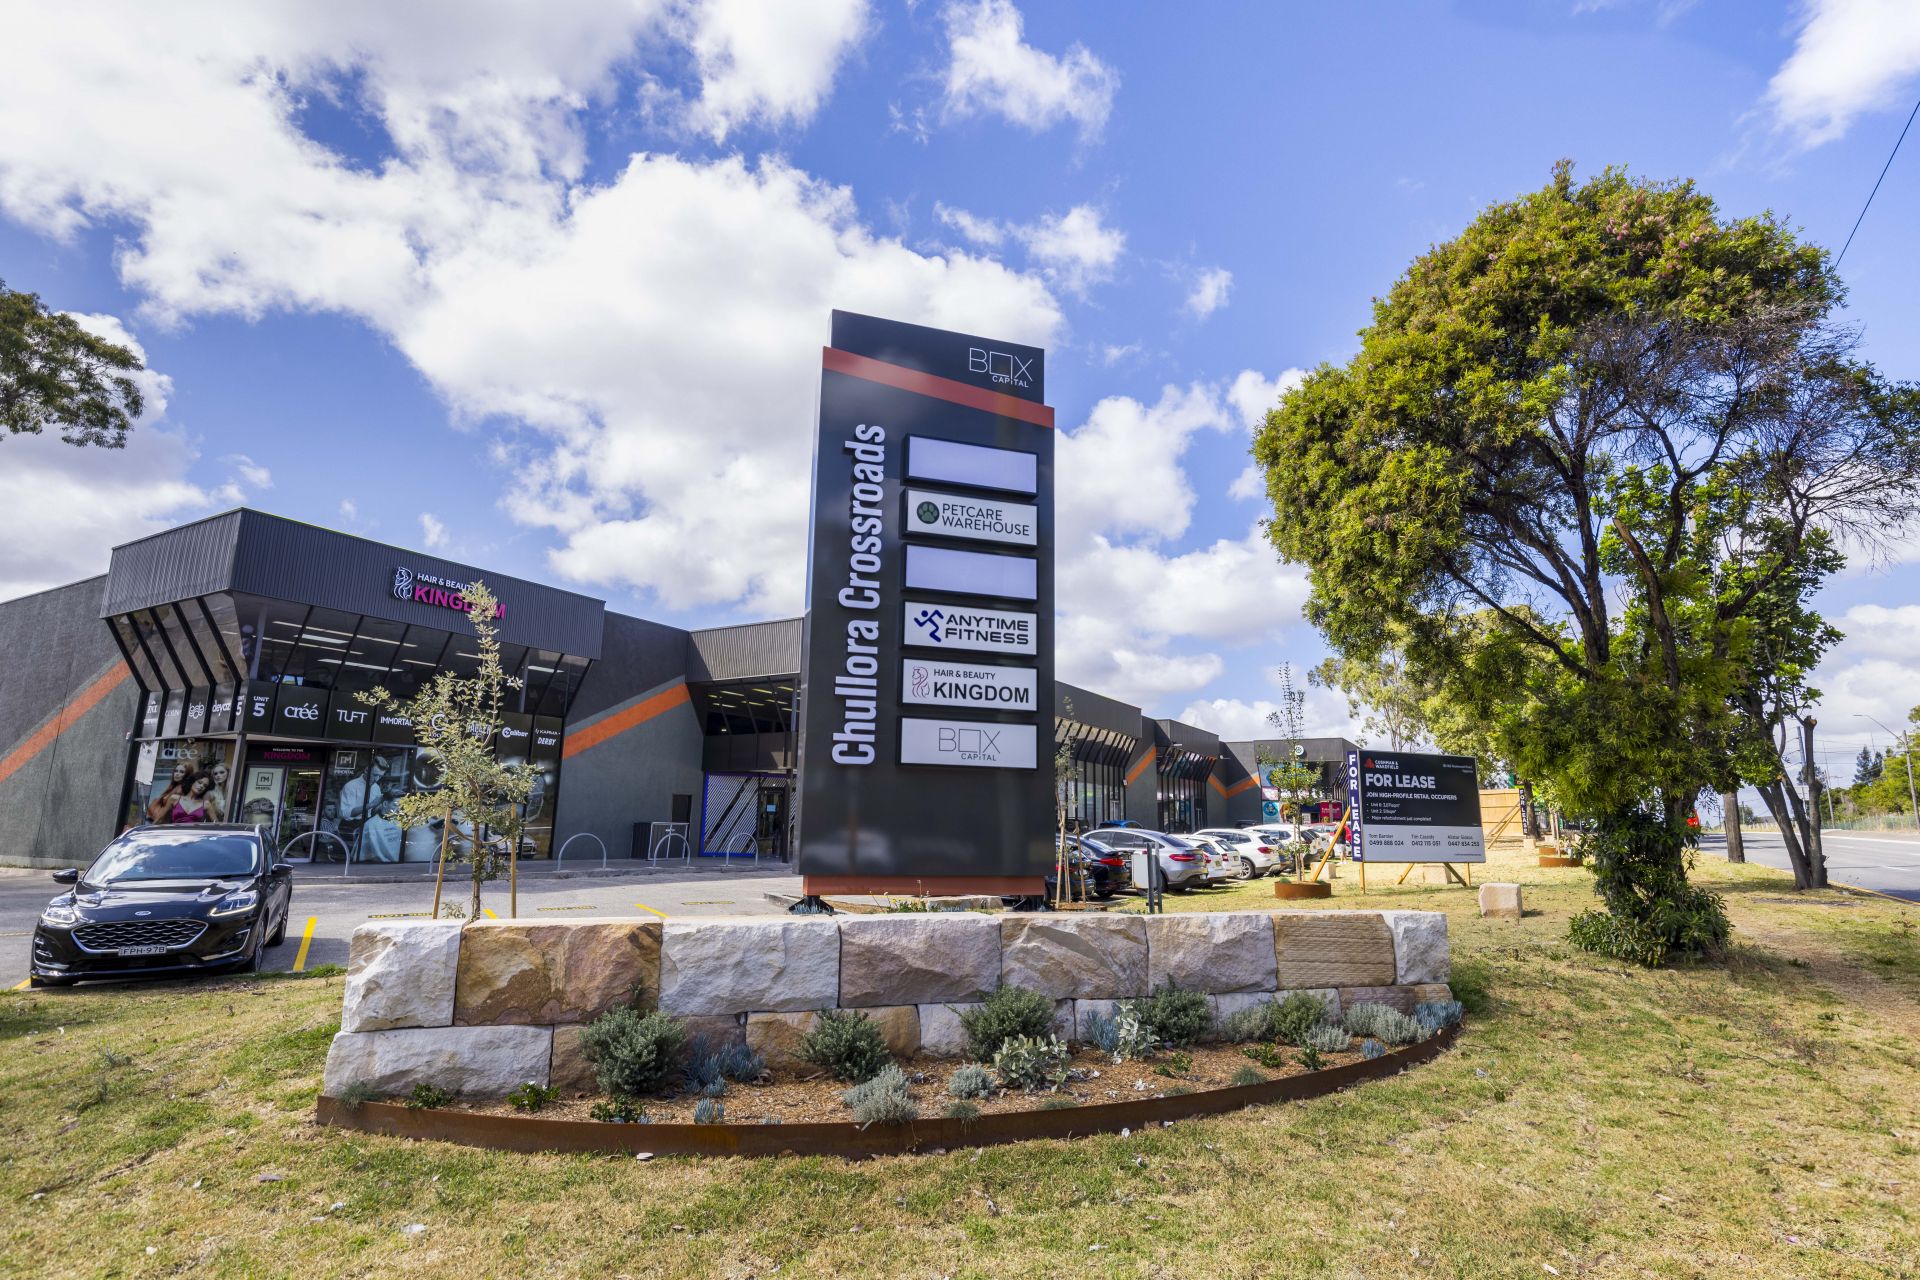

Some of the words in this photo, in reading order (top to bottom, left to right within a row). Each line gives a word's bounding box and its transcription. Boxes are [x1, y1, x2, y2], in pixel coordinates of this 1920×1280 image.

[969, 347, 1033, 382] BOX
[992, 375, 1029, 388] CAPITAL
[838, 423, 886, 610] Crossroads
[942, 503, 1003, 521] PETCARE
[941, 515, 1030, 536] WAREHOUSE
[417, 572, 438, 585] HAIR
[438, 577, 445, 586] &
[945, 614, 1029, 632] ANYTIME
[945, 627, 1029, 645] FITNESS
[933, 668, 954, 678] HAIR
[955, 670, 961, 678] &
[962, 670, 996, 680] BEAUTY
[253, 695, 270, 703] UNIT
[831, 619, 879, 766] Chullora
[933, 681, 1029, 703] KINGDOM
[252, 702, 266, 717] 5
[284, 702, 319, 720] créé
[336, 709, 368, 724] TUFT
[380, 716, 414, 726] IMMORTAL
[537, 736, 557, 746] DERBY
[938, 727, 1001, 754] BOX
[263, 751, 311, 760] KINGDOM
[960, 752, 997, 762] CAPITAL
[1348, 754, 1358, 790] FOR
[1365, 773, 1393, 787] FOR
[1395, 774, 1436, 789] LEASE
[1351, 796, 1362, 857] LEASE
